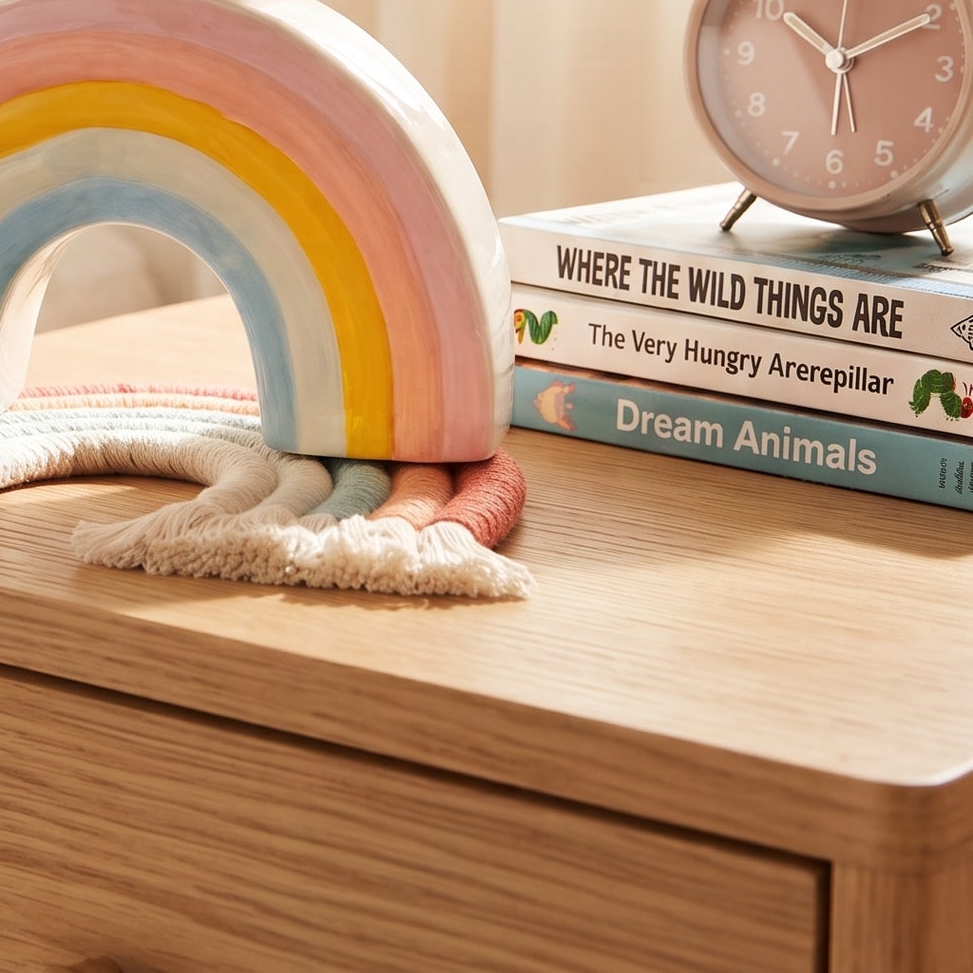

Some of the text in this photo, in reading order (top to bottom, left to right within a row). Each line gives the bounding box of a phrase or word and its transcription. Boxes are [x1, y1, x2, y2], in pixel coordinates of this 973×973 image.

[926, 4, 943, 29] 2
[737, 42, 755, 66] 9
[935, 56, 953, 82] 3
[747, 92, 765, 116] 8
[914, 107, 934, 133] 4
[781, 131, 800, 155] 7
[875, 141, 893, 166] 5
[826, 150, 844, 174] 6
[557, 245, 905, 339] WHERE THE WILD THINGS ARE
[588, 323, 895, 395] The Very Hungry Arerepillar
[616, 399, 723, 448] Dream
[733, 420, 877, 475] Animals
